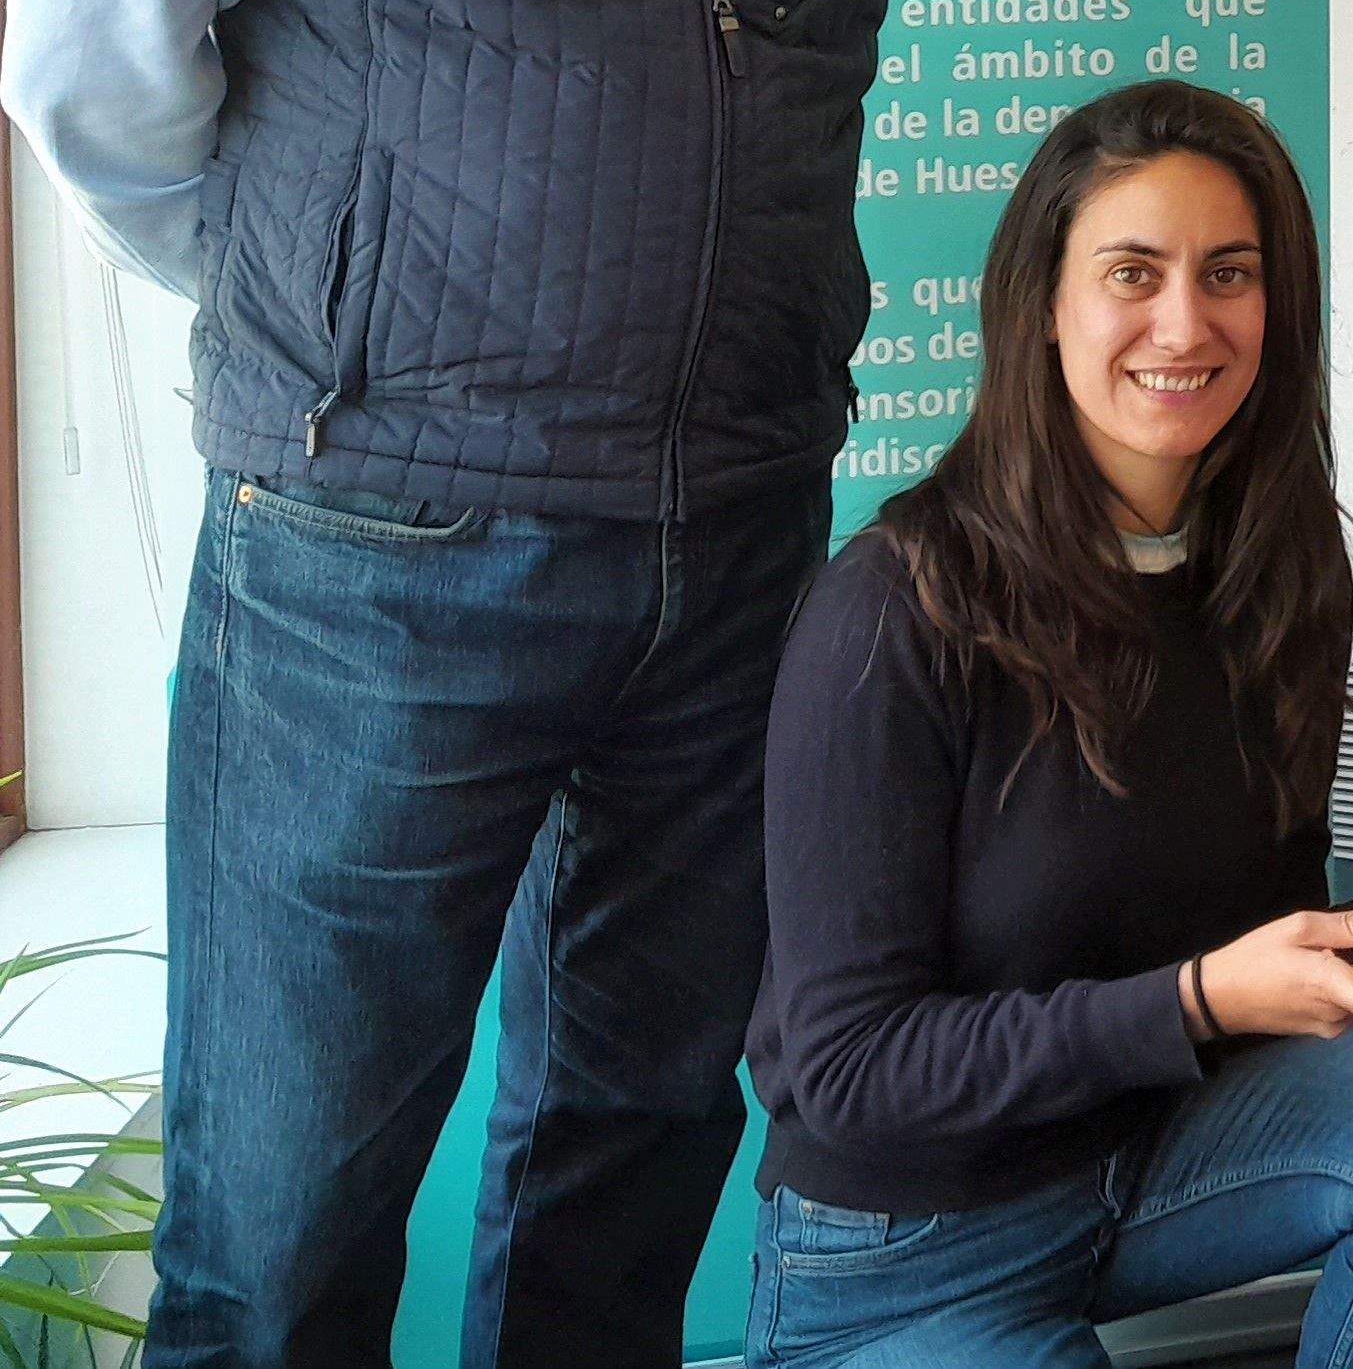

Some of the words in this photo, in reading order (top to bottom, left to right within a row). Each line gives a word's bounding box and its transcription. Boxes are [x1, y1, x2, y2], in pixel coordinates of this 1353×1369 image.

[881, 43, 921, 84] el
[952, 38, 1115, 80] ámbito
[1145, 34, 1198, 73] de
[1228, 33, 1266, 70] la
[874, 100, 929, 140] de
[943, 97, 980, 137] la
[916, 157, 1019, 195] Hues
